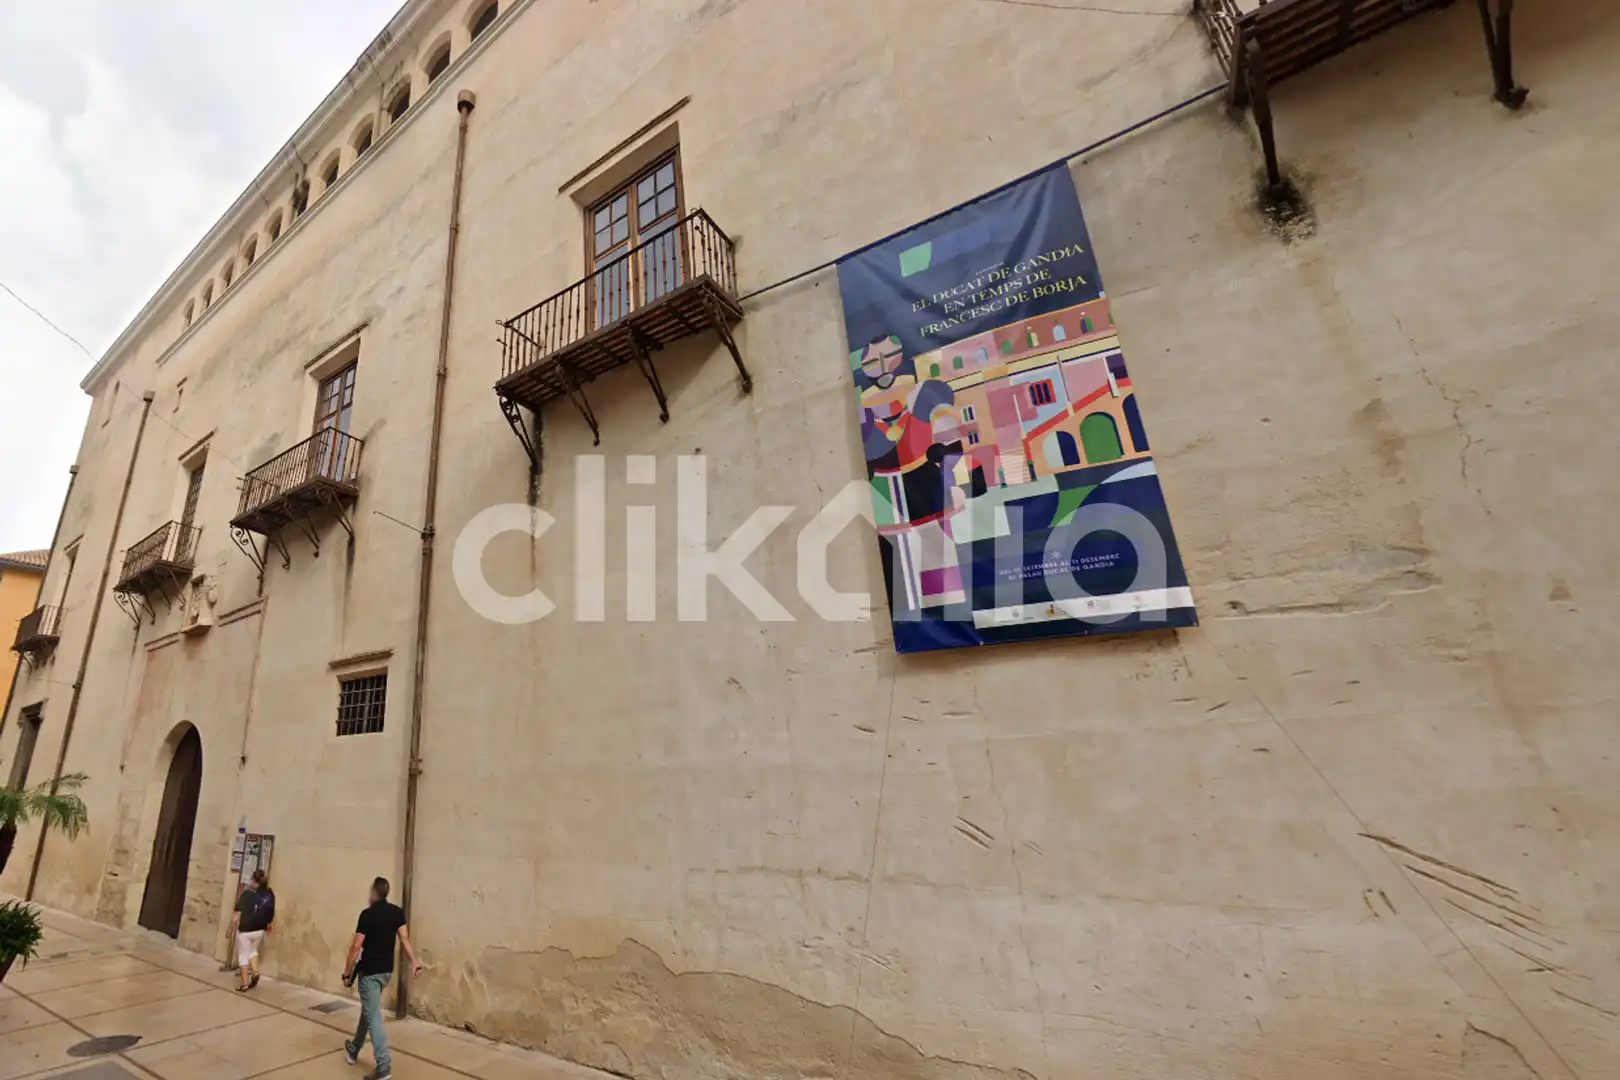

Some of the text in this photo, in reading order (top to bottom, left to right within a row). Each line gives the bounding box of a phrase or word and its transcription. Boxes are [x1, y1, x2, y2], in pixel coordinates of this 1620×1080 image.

[911, 298, 931, 313] EL
[932, 276, 986, 304] DUCAT
[987, 266, 1013, 283] DE
[1013, 244, 1084, 274] GANDIA
[943, 268, 1052, 314] EN TEMPS DE
[919, 275, 1088, 338] FRANCESC DE BORJA
[1044, 566, 1070, 576] DUCAL
[1082, 560, 1115, 570] GANDIA
[1080, 552, 1120, 565] DESEMBRE
